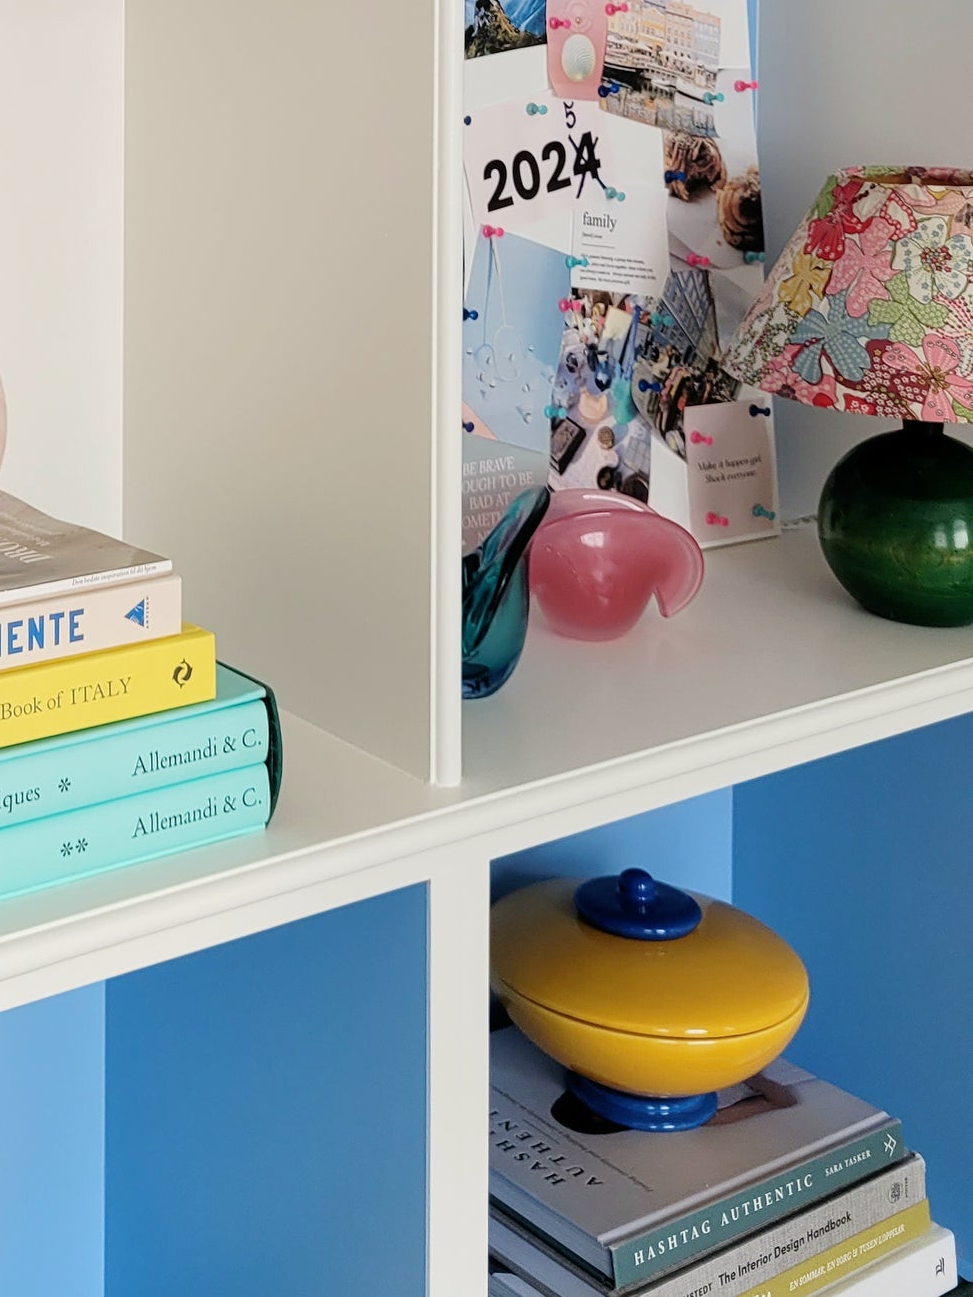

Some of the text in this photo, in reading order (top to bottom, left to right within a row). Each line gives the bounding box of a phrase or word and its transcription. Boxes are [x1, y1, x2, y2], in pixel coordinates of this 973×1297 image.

[563, 101, 577, 129] 5
[582, 211, 617, 232] family
[463, 455, 515, 476] BE BRAVE
[499, 473, 517, 488] TO
[518, 471, 534, 486] BE
[469, 494, 493, 510] BAD
[0, 696, 42, 721] Book
[47, 691, 64, 711] of
[71, 676, 132, 705] ITALY
[132, 728, 262, 777] Allemandi & C.
[132, 786, 262, 839] Allemandi & C.
[633, 1149, 872, 1267] HASHTAG AUTHENTIC SARA TASKER
[718, 1271, 736, 1287] The
[738, 1253, 773, 1277] Interior
[774, 1236, 805, 1259] Design
[807, 1210, 853, 1242] Handbook
[789, 1279, 799, 1291] EN
[827, 1261, 836, 1272] EN
